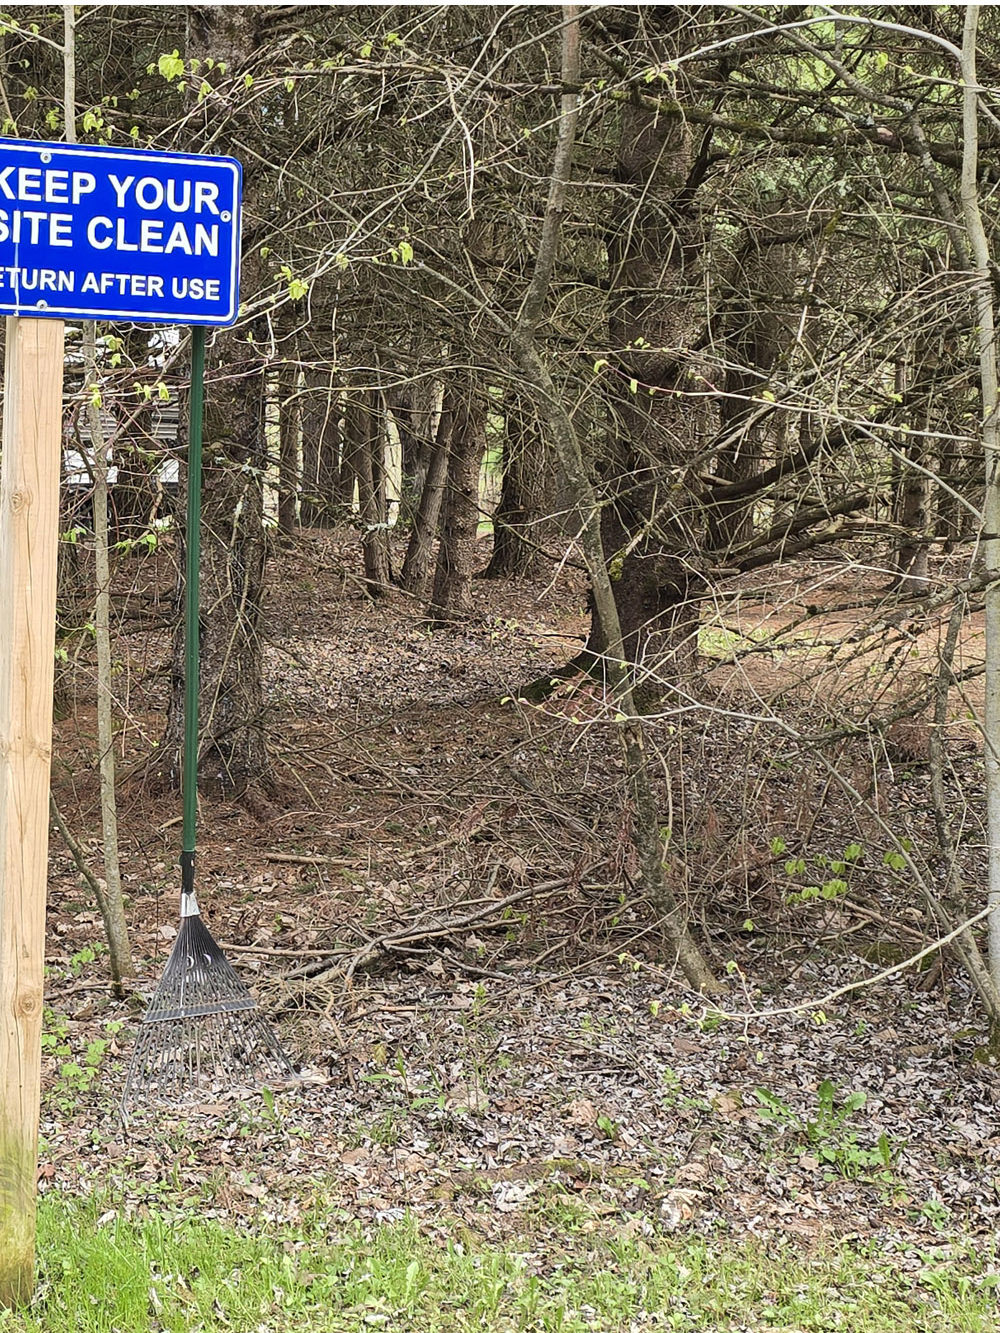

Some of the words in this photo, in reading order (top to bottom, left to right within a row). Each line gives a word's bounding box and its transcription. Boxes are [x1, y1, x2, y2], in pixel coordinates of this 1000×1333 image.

[107, 174, 220, 215] YOUR
[86, 215, 219, 257] CLEAN
[81, 272, 166, 298] AFTER
[171, 278, 221, 301] USE
